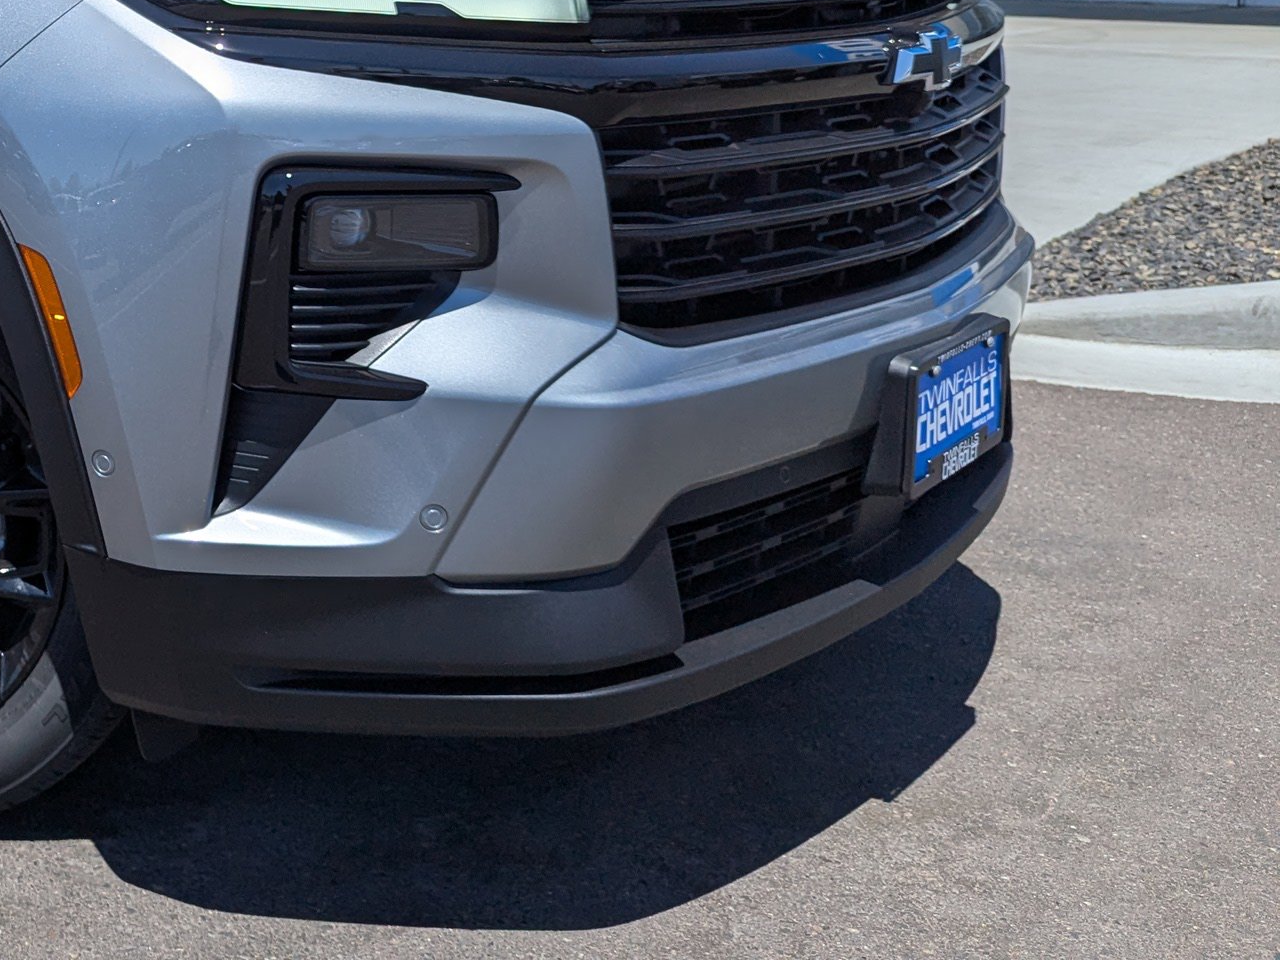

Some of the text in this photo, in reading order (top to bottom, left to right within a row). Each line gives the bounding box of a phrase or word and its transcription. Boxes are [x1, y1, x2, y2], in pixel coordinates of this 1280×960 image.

[916, 371, 997, 453] CHEVROLET
[918, 350, 997, 412] TWINFALLS
[942, 444, 979, 480] CHEVROLET
